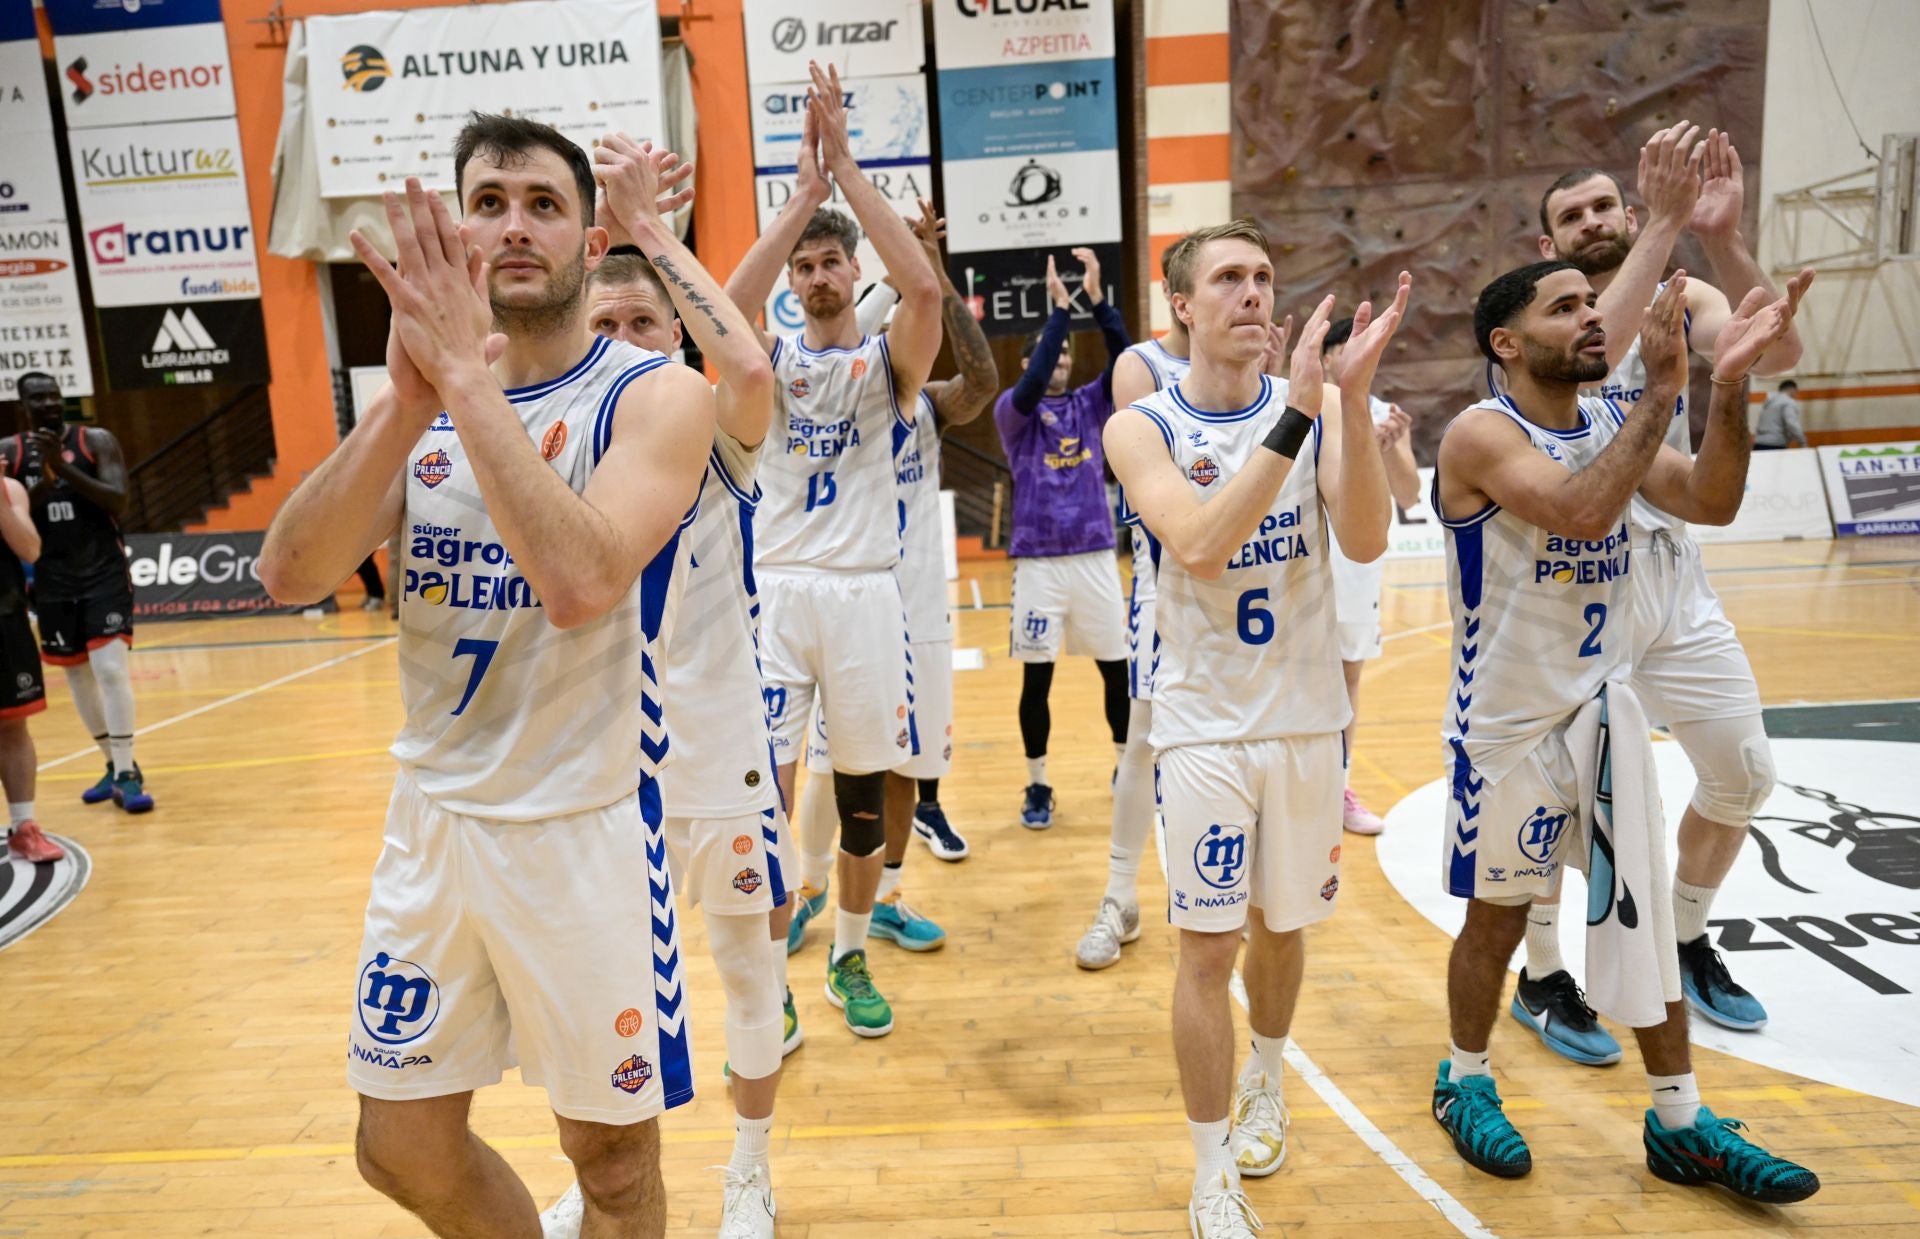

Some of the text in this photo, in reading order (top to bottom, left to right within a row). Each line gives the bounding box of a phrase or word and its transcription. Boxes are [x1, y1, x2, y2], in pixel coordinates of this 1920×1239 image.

[402, 40, 629, 78] ALTUNA Y URIA
[1003, 33, 1094, 57] AZPEITIA
[98, 62, 223, 95] sidenor
[93, 224, 250, 262] aranur
[181, 276, 257, 296] fundibide
[412, 522, 461, 538] súper
[1226, 533, 1310, 570] LENCIA
[1236, 587, 1275, 645] 6
[1578, 603, 1608, 658] 2
[450, 638, 500, 716] 7
[1706, 911, 1920, 995] zpe
[353, 1043, 433, 1069] INMAPA
[612, 1064, 652, 1086] PALENCIA
